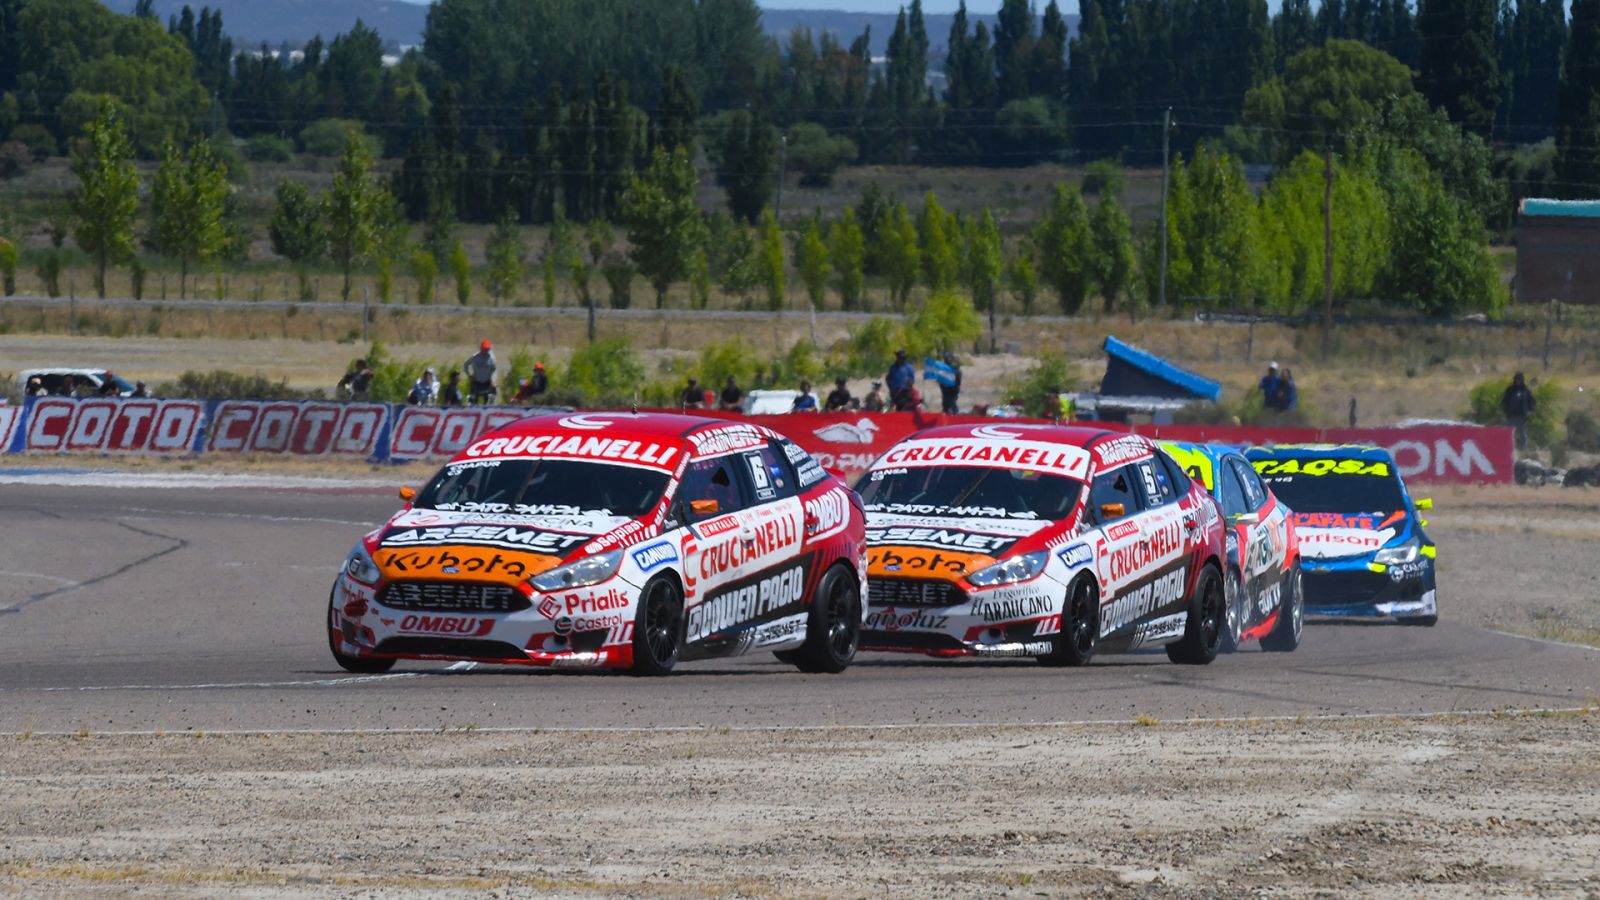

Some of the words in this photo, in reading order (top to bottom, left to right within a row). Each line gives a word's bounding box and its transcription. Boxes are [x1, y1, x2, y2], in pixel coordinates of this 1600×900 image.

[29, 404, 195, 450] COTO
[211, 408, 381, 453] COTO
[466, 436, 678, 466] CRUCIANELLI
[886, 445, 1084, 472] CRUCIANELLI
[1386, 440, 1496, 476] OM
[750, 455, 769, 489] 6
[1141, 465, 1156, 495] 5
[805, 489, 842, 533] OMBU
[386, 525, 590, 548] ARSEMET
[701, 513, 798, 580] CRUCIANELLI
[865, 528, 1016, 549] RSEMET
[1298, 533, 1379, 546] rrison
[385, 551, 526, 577] Kubota
[868, 551, 967, 573] bota
[1110, 520, 1180, 582] CRUCIANELLI
[386, 582, 514, 610] ARSEMET
[565, 588, 629, 615] Prialis
[757, 565, 803, 616] PAGIO
[869, 580, 952, 604] SEMET
[574, 613, 623, 630] Castrol
[984, 595, 1053, 622] ARAUCANO
[400, 615, 484, 633] OMBU
